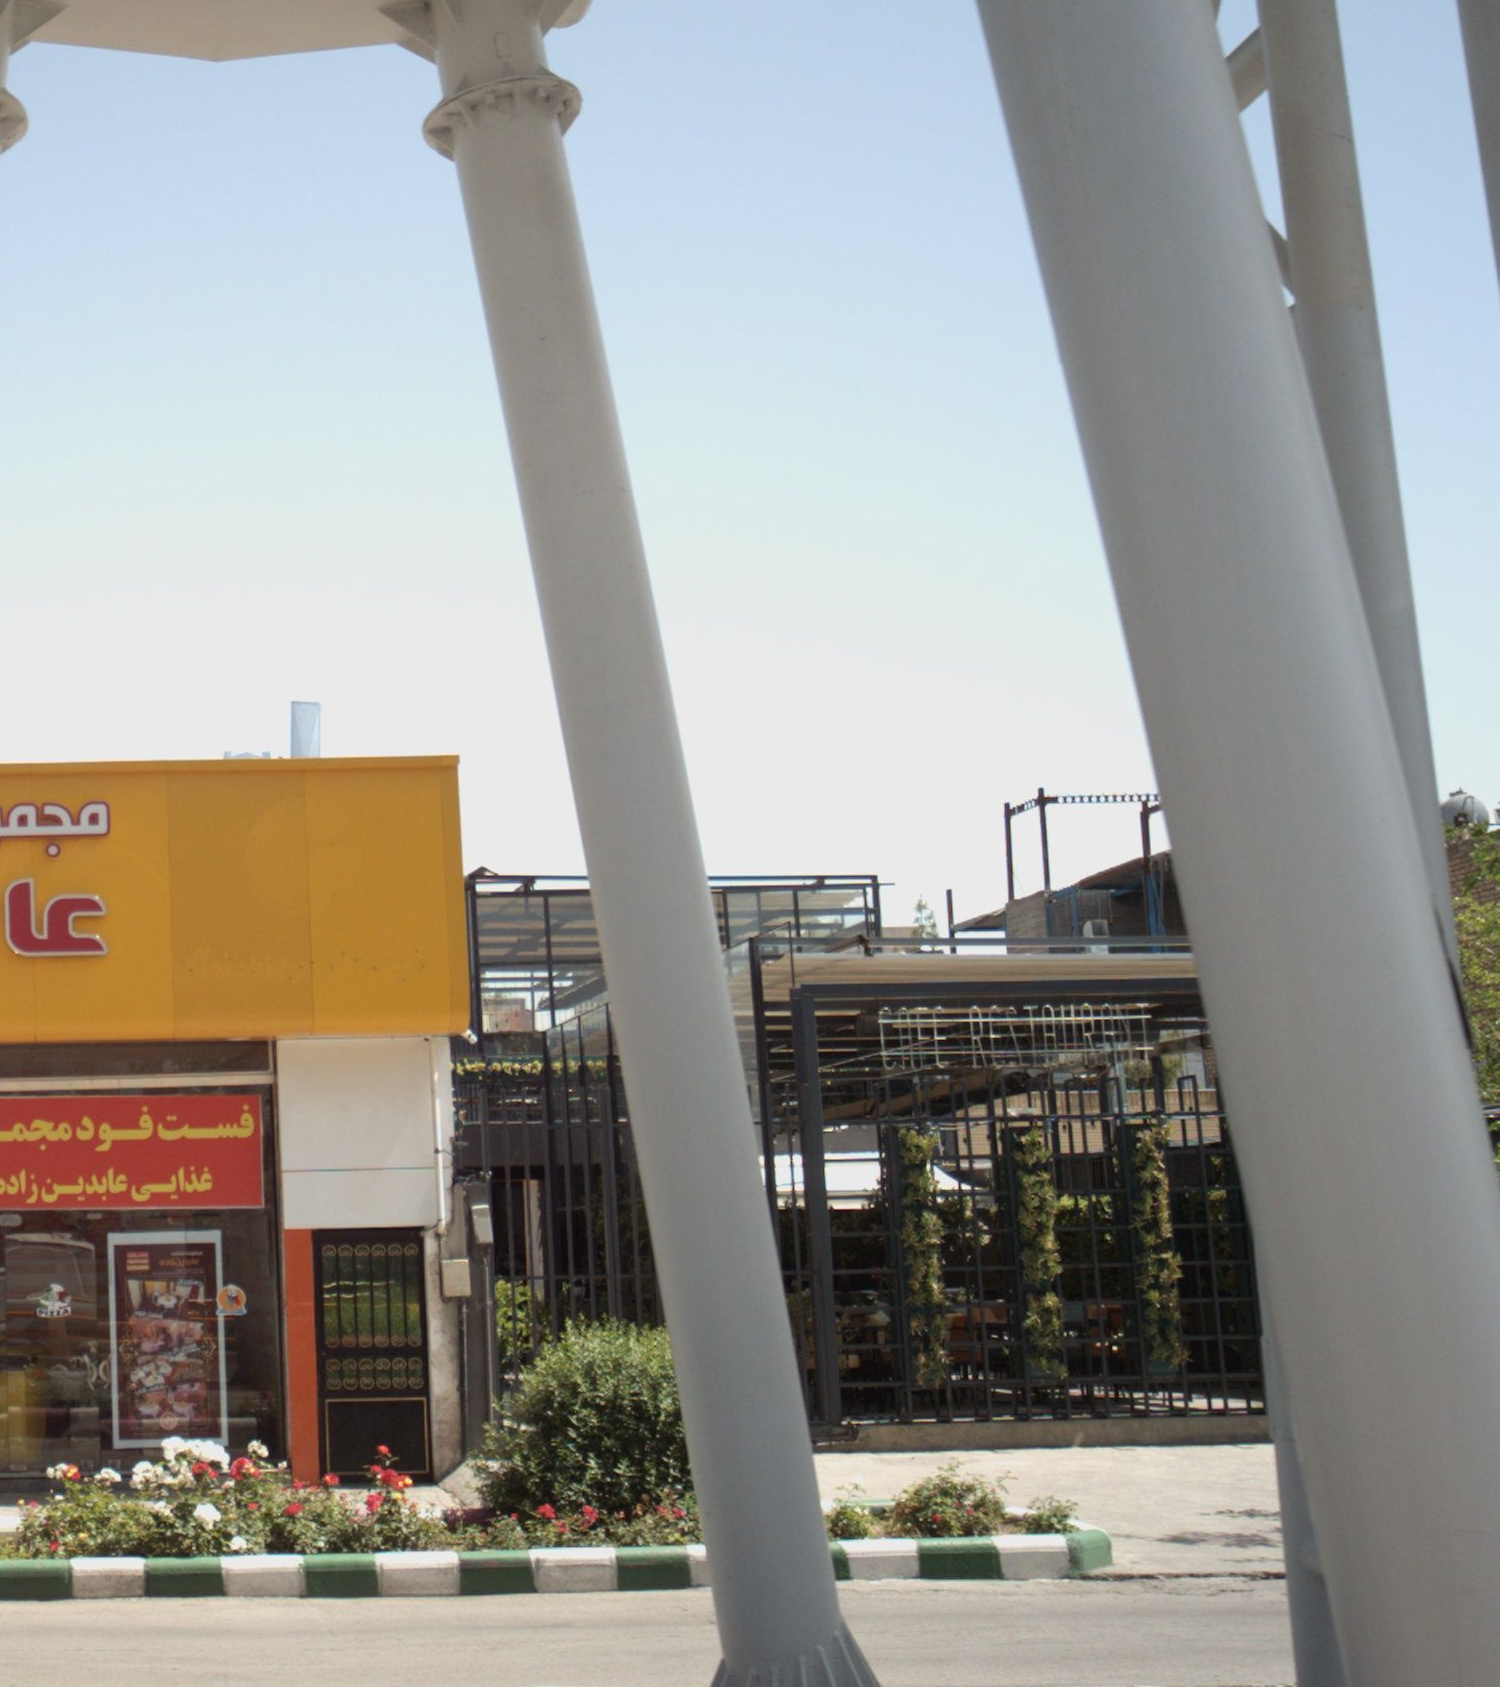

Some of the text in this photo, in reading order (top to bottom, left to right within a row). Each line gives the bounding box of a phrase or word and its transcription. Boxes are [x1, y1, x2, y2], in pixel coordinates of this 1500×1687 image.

[878, 1005, 947, 1069] CAFE
[75, 1105, 154, 1152] فود
[157, 1104, 255, 1141] فست
[41, 1167, 129, 1204] عابدین
[131, 1165, 213, 1202] غذایی
